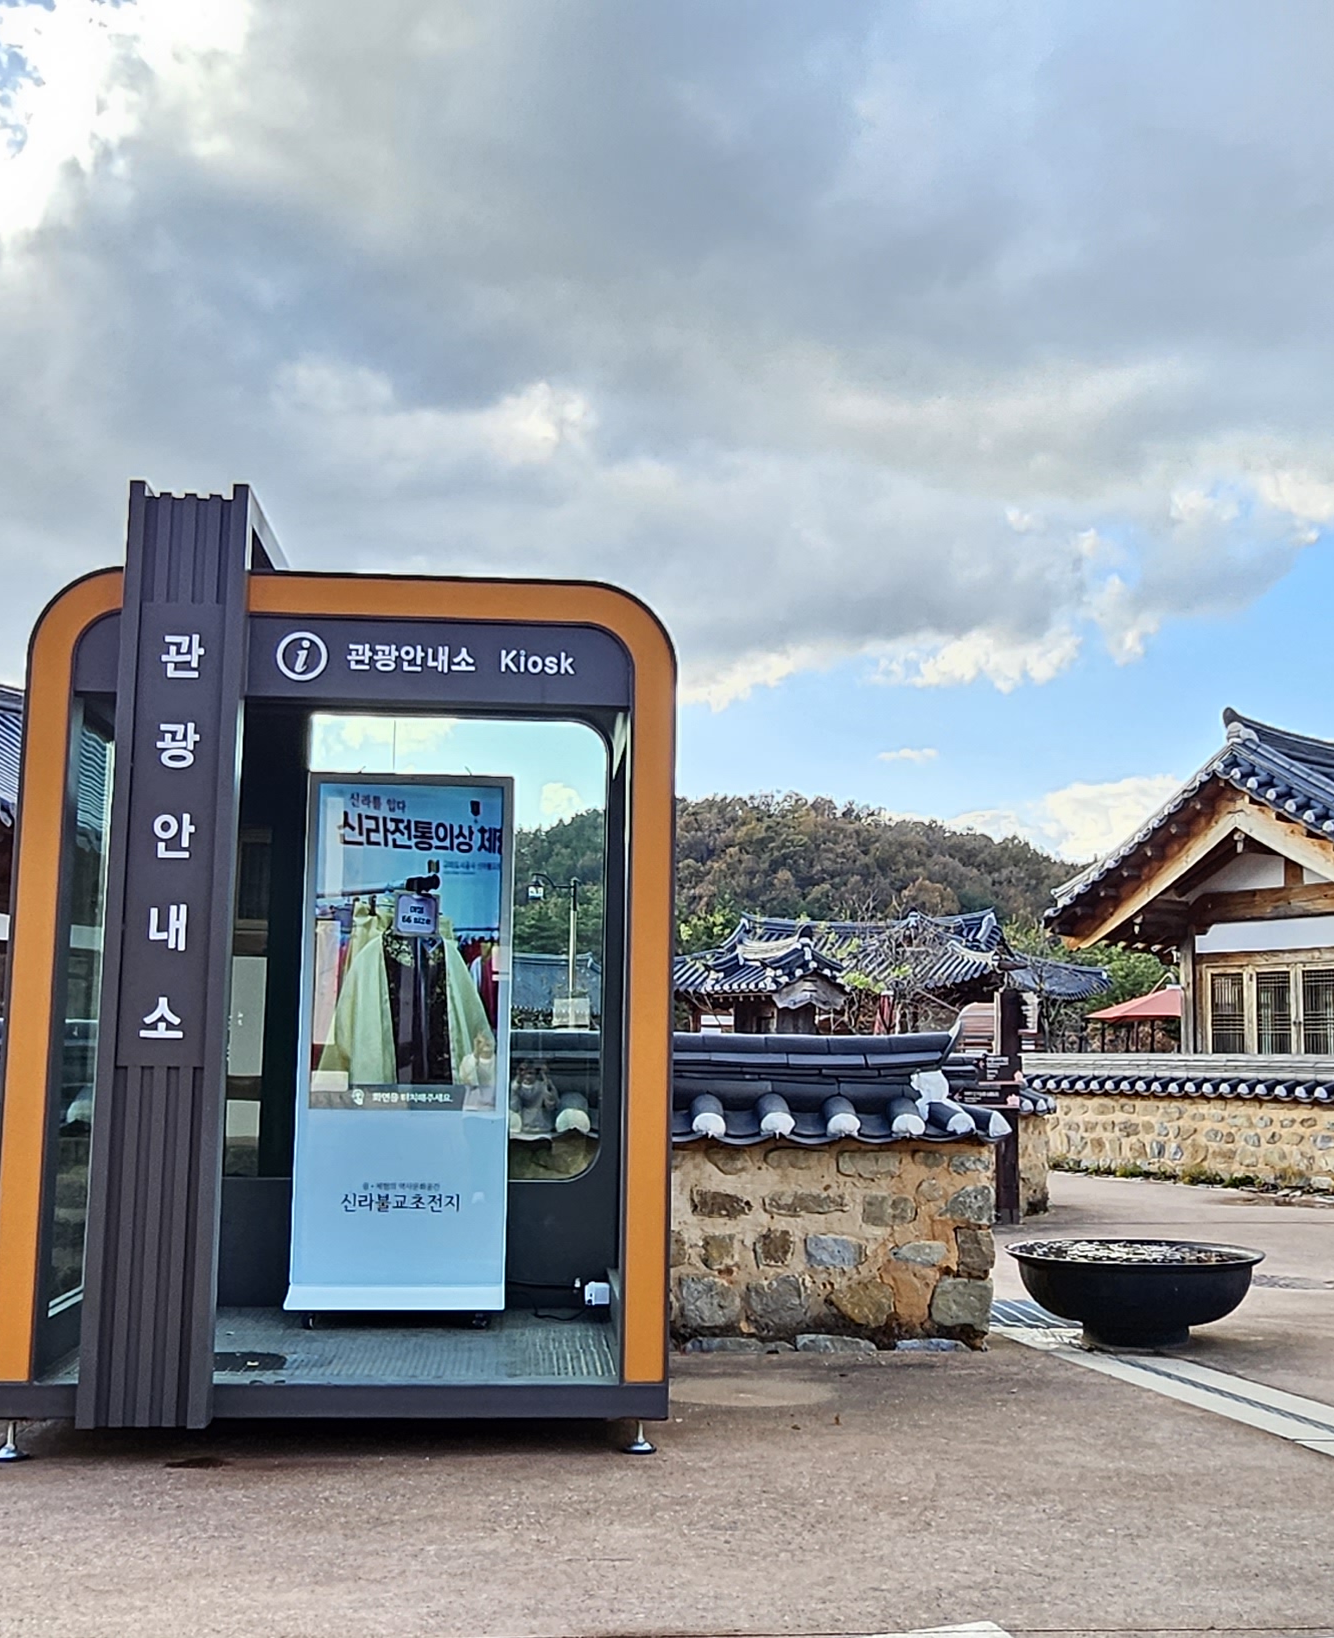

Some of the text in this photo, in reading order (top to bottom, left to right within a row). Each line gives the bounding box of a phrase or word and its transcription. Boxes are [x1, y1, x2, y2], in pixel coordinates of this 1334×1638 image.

[347, 643, 575, 675] 관광안내소 Kiosk
[350, 792, 382, 811] 신라를
[139, 634, 205, 1040] 관광안내소
[339, 811, 474, 854] 신라전통의상
[372, 1092, 399, 1103] 화면을
[341, 1193, 461, 1213] 신라불교초전지
